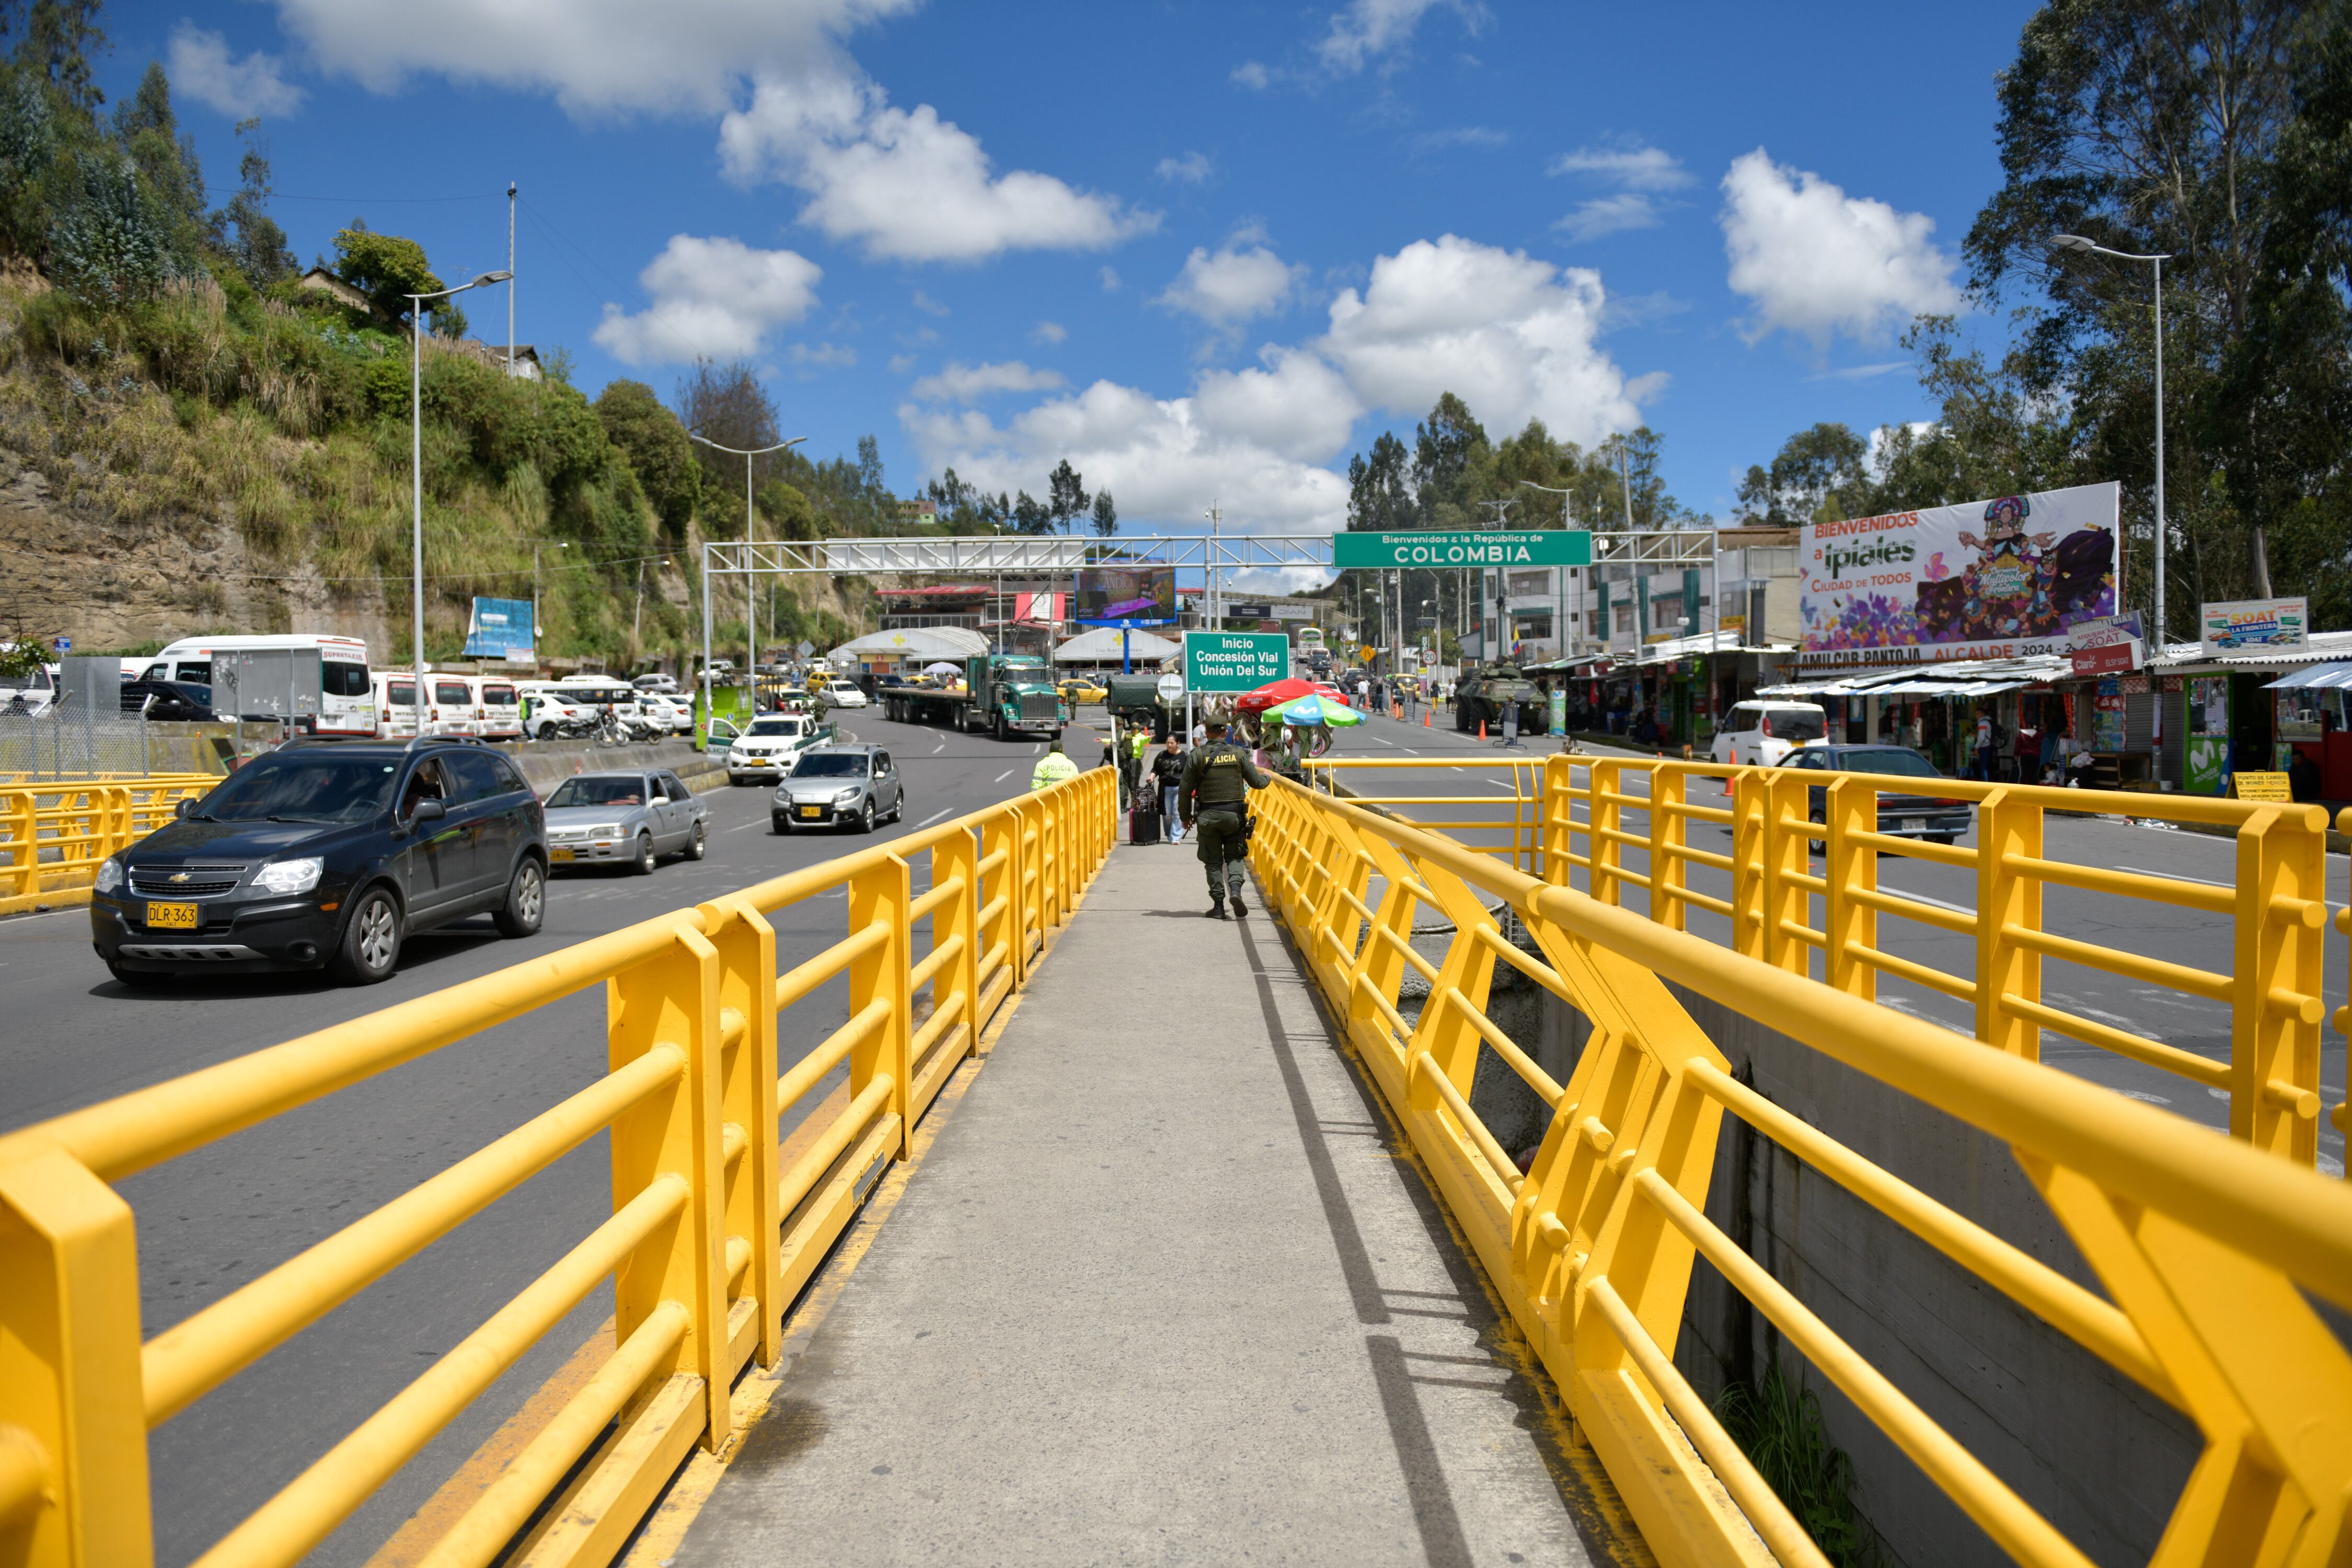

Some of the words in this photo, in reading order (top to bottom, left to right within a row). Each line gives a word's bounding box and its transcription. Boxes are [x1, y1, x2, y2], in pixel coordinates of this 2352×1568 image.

[1815, 512, 1918, 538] BIENVENIDOS
[1382, 535, 1448, 543] Bienvenidos
[1473, 534, 1527, 544] República
[1530, 533, 1543, 541] de
[1394, 546, 1531, 563] COLOMBIA
[1814, 549, 1823, 560] a
[1871, 572, 1912, 586] TODOS
[2231, 610, 2275, 625] SOAT
[2242, 622, 2277, 632] FRONTERA
[2077, 630, 2105, 640] ADQUIERA
[2087, 632, 2120, 648] SOAT
[1223, 637, 1253, 649] Inicio
[1196, 651, 1254, 662] Concesión
[1258, 652, 1278, 662] Vial
[1801, 652, 1859, 671] AMILCAR
[1864, 648, 1921, 668] PANTOJA
[1935, 644, 2014, 660] ALCALDE
[2021, 644, 2052, 655] 2024
[2076, 658, 2095, 670] Claro
[2117, 657, 2129, 665] SOAT
[1200, 664, 1233, 675] Unión
[1237, 665, 1254, 675] Del
[1258, 665, 1277, 676] Sur
[1205, 754, 1237, 764] PLICIA
[149, 907, 170, 921] DLR
[174, 908, 194, 922] 363
